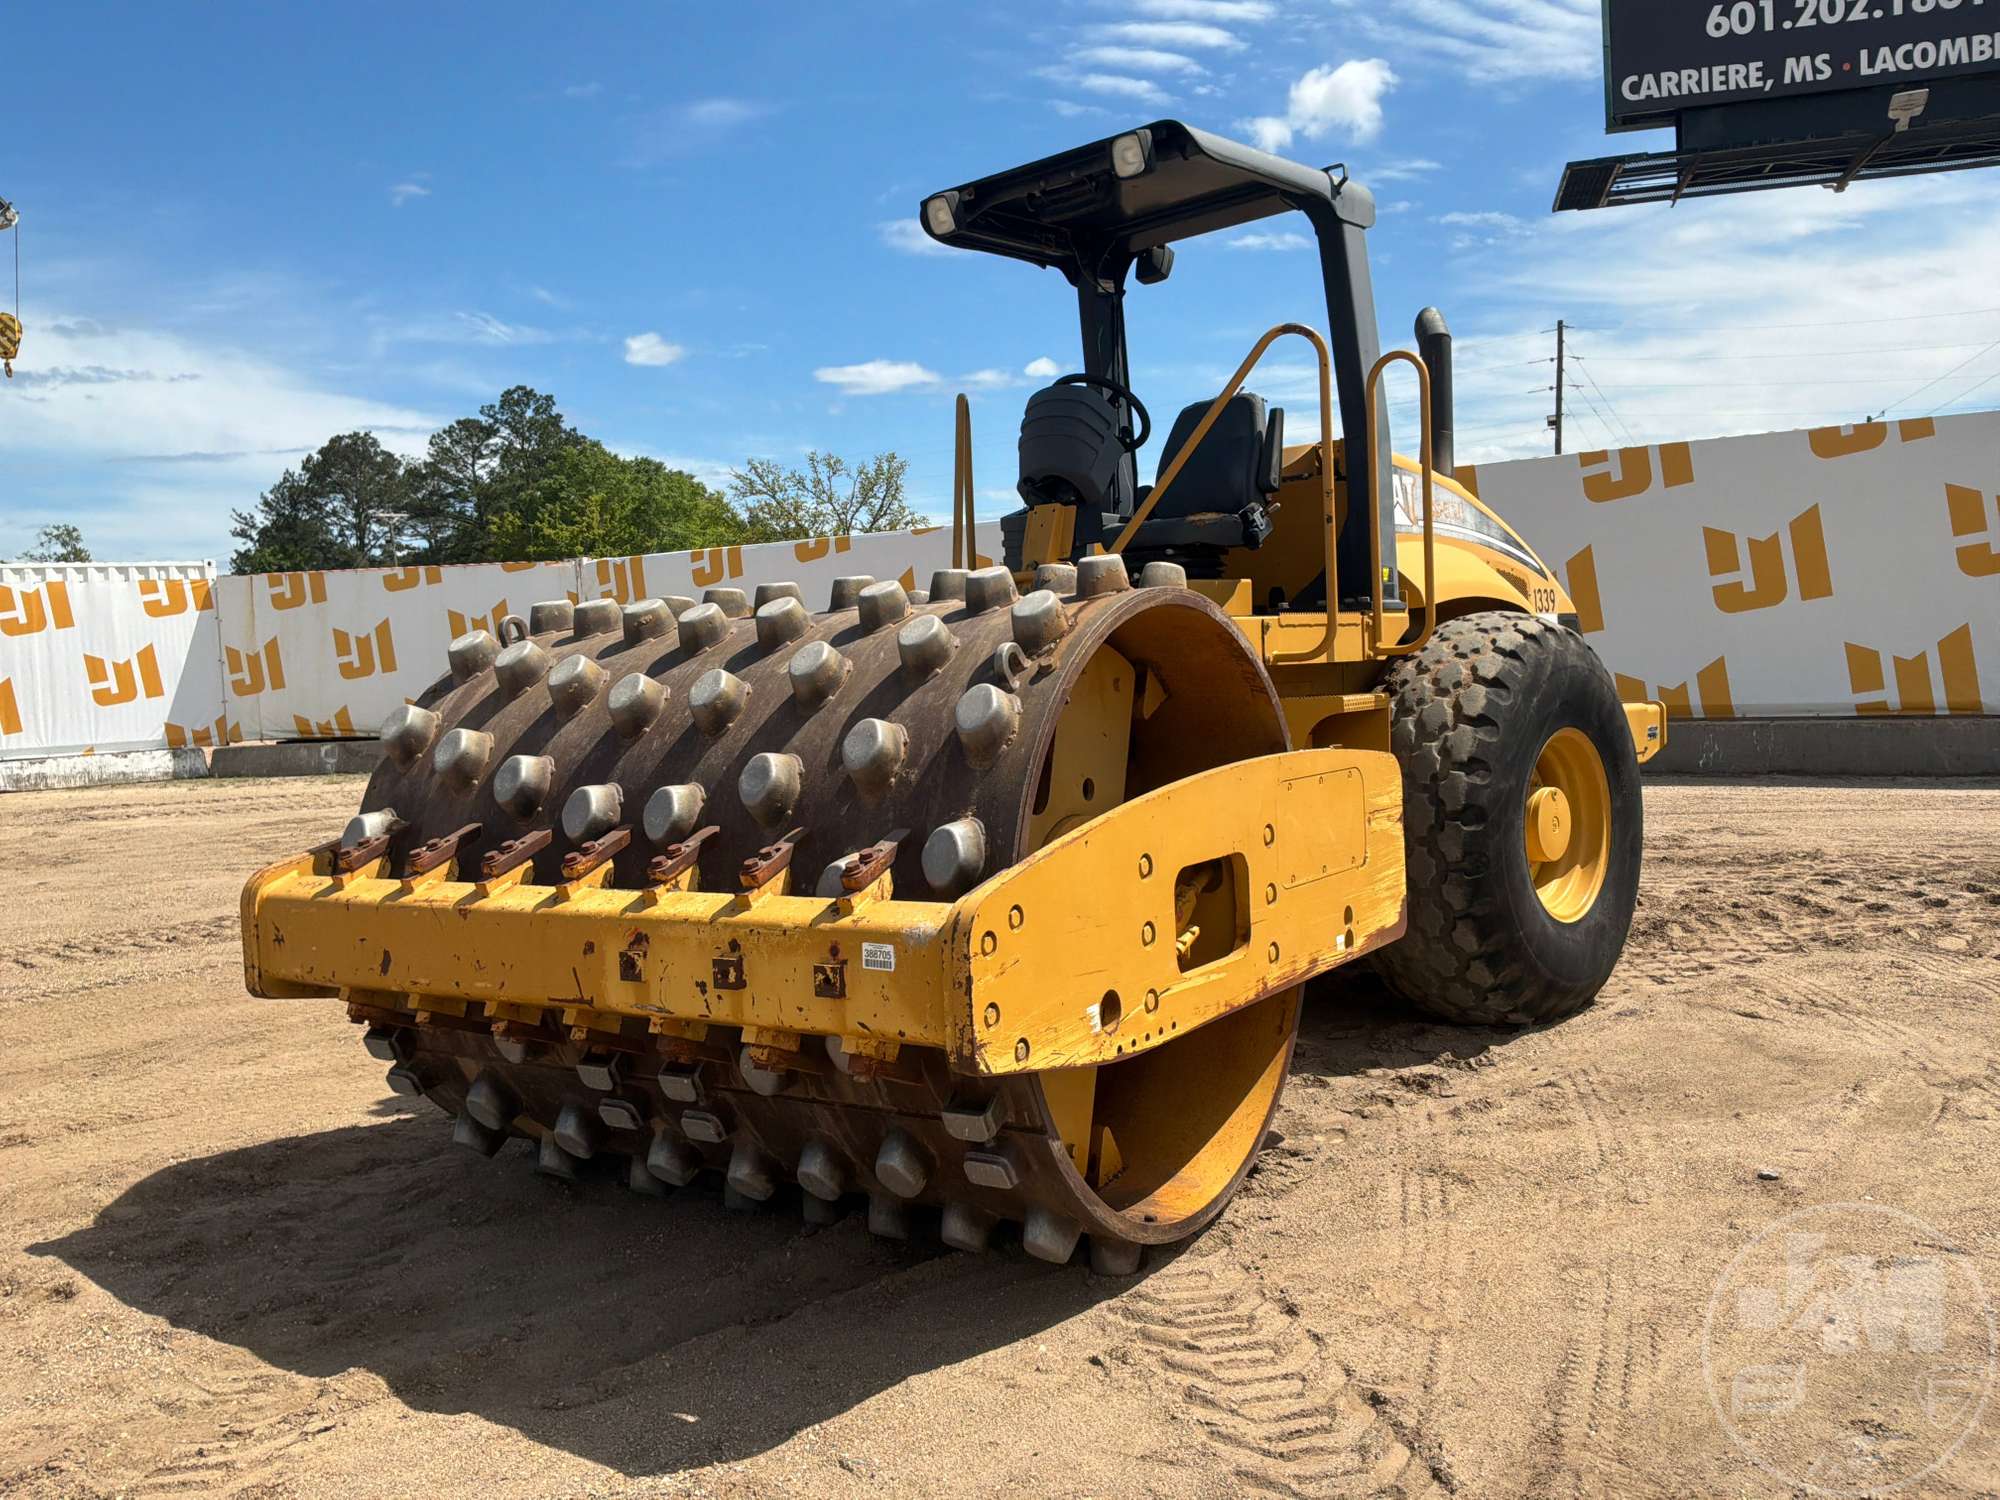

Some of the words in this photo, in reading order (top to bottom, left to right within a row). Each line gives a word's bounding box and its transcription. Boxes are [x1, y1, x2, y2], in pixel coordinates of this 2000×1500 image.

[1706, 0, 1985, 38] 601.202.
[1621, 61, 1774, 100] CARRIERE,
[1784, 53, 1832, 84] MS
[1534, 588, 1555, 613] 1339
